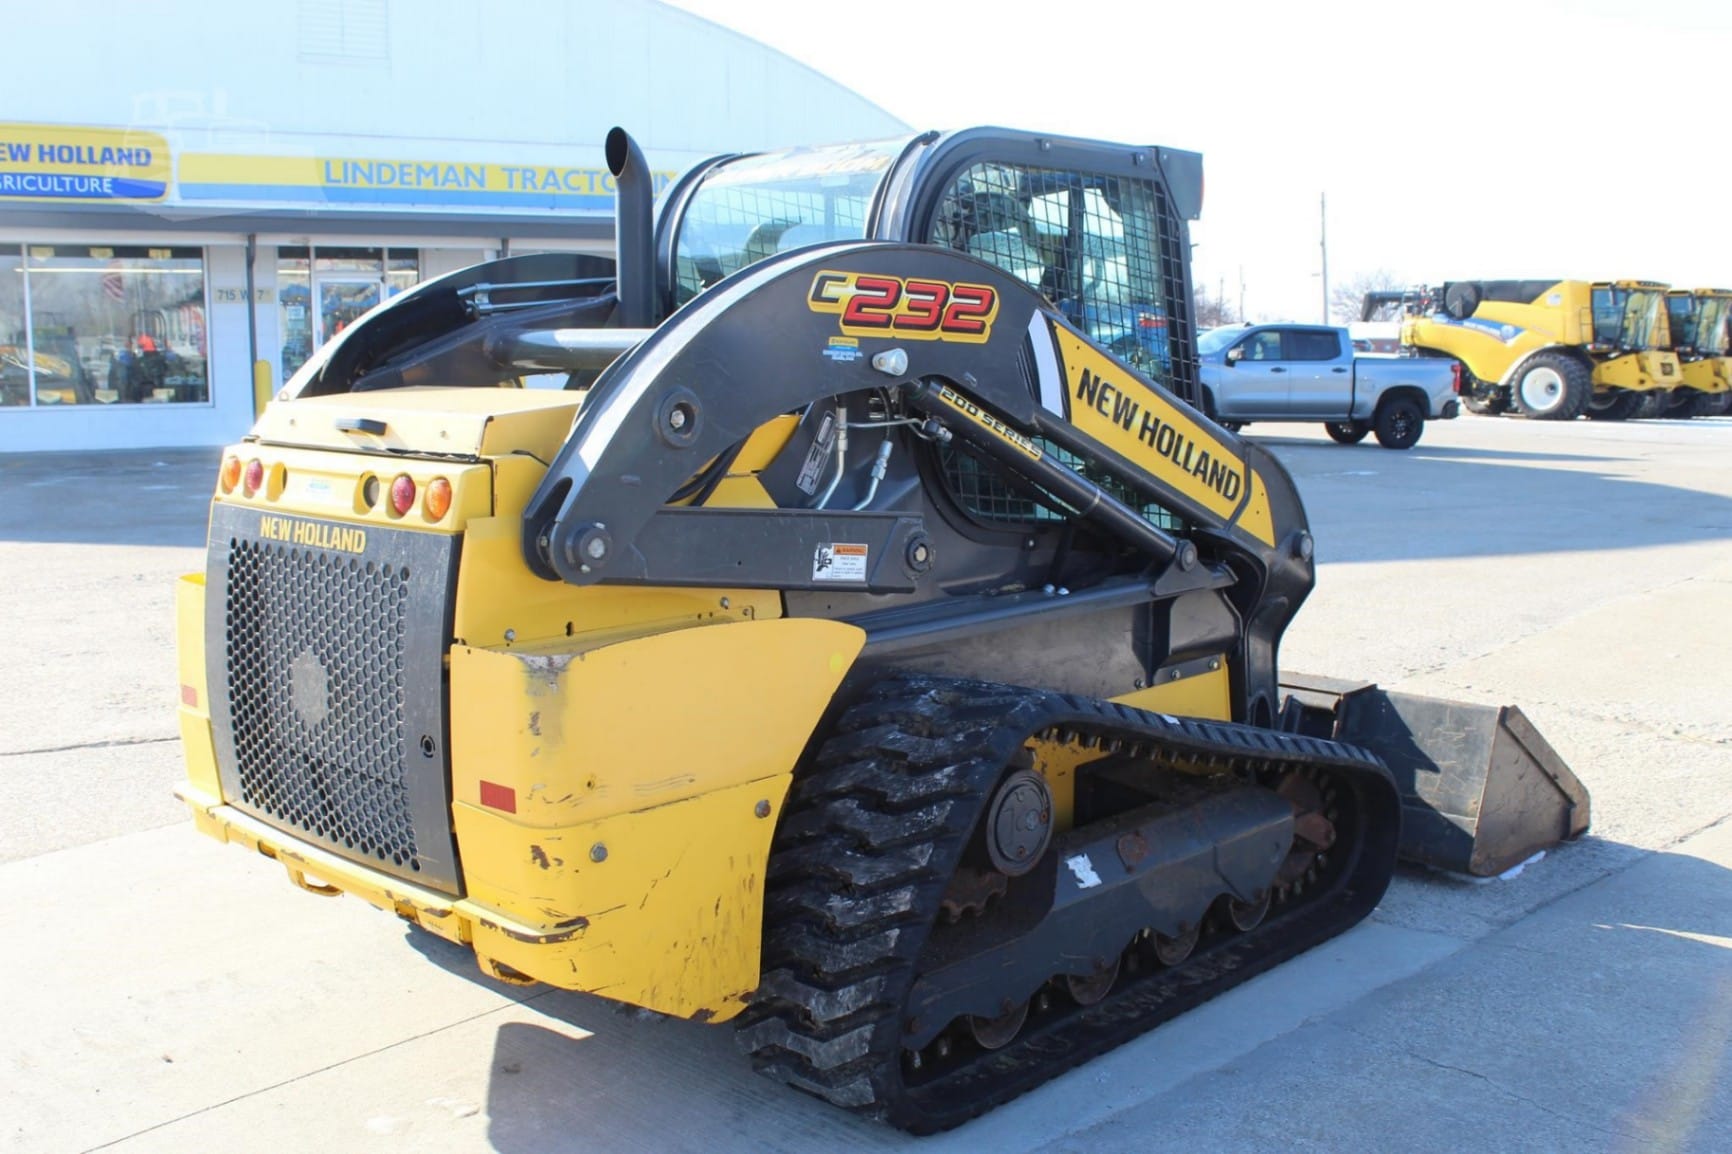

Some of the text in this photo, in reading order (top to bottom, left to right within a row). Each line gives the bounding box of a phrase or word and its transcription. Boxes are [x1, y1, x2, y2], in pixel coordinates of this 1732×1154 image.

[0, 142, 152, 166] EW HOLLAND
[0, 174, 113, 193] RICULTURE
[324, 160, 486, 189] LINDEMAN
[502, 167, 617, 194] TRACTO
[217, 289, 236, 300] 715
[809, 272, 998, 340] C232
[940, 387, 1040, 457] 200 SERIES
[1076, 367, 1241, 502] NEW HOLLAND
[260, 516, 366, 553] NEW HOLLAND
